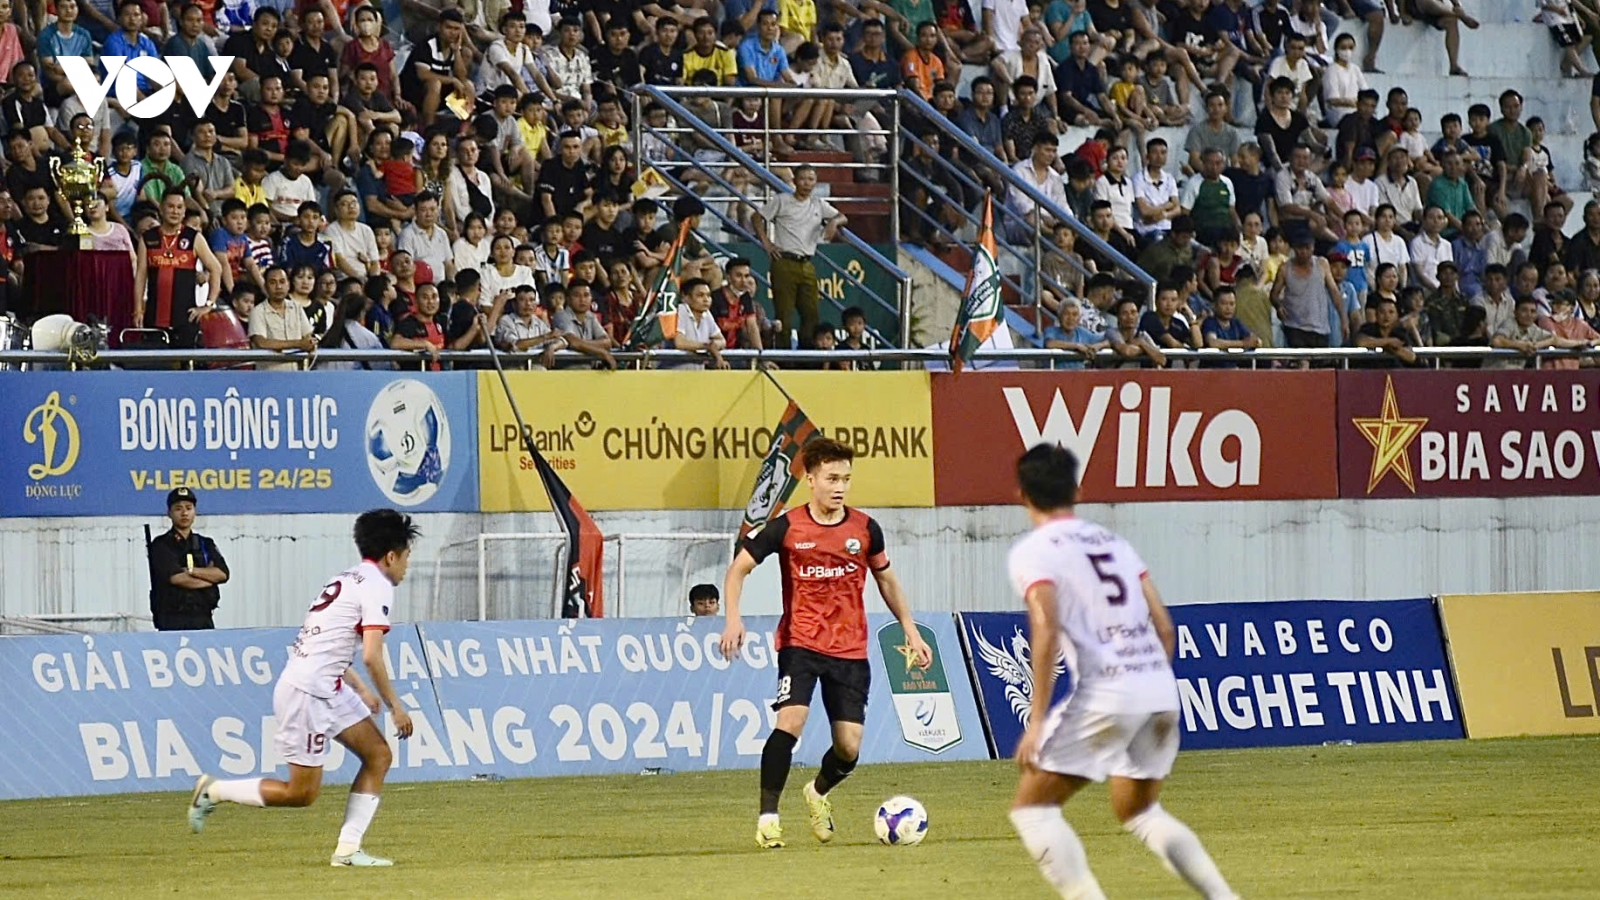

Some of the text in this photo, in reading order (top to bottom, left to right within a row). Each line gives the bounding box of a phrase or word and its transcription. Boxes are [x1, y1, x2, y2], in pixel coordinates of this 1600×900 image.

[1456, 383, 1587, 413] SAVAB
[119, 386, 338, 460] BÓNG ĐỘNG LỰC
[490, 424, 575, 452] LPBank
[602, 416, 929, 460] CHỨNG KHO PBANK
[1002, 381, 1262, 489] Wika
[519, 456, 576, 470] Serities
[1420, 430, 1491, 481] BIA
[1500, 429, 1585, 480] SAO
[130, 468, 333, 491] V-LEAGUE 24/25
[799, 565, 845, 578] LPBank
[1086, 552, 1127, 606] 5
[32, 634, 131, 693] GIẢI
[142, 636, 272, 689] BÓNG
[498, 617, 602, 677] NHẤT
[616, 616, 731, 673] QUỐC
[740, 630, 780, 670] GI
[1177, 617, 1395, 659] AVABECO
[1176, 667, 1454, 732] NGHE TINH
[79, 718, 202, 782] BIA
[307, 733, 326, 754] 19
